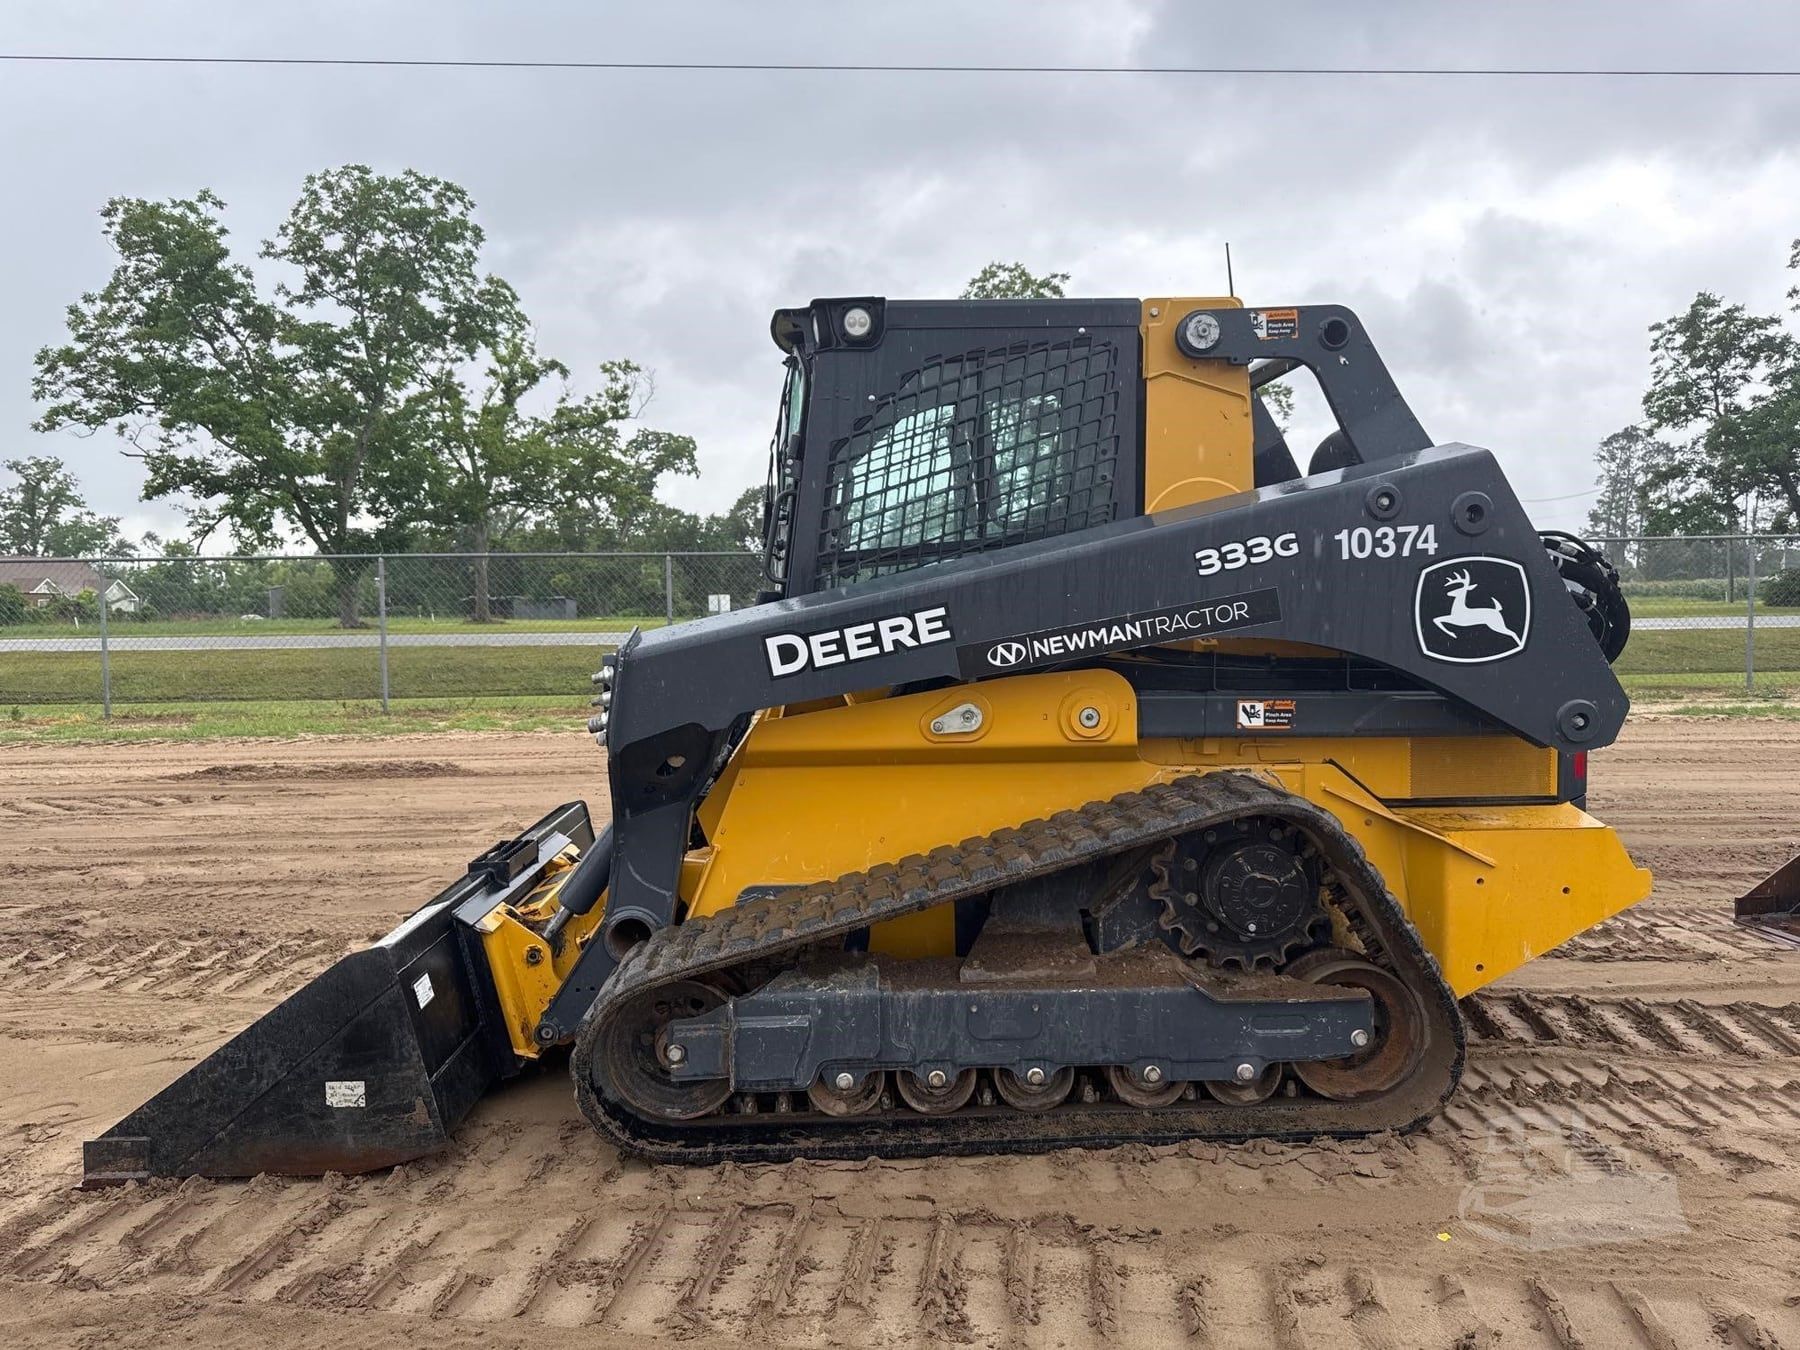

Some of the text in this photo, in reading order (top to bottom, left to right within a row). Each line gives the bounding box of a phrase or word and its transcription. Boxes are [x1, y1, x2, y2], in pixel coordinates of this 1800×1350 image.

[1195, 533, 1299, 576] 333G
[1335, 524, 1438, 560] 10374
[765, 607, 951, 677] DEERE
